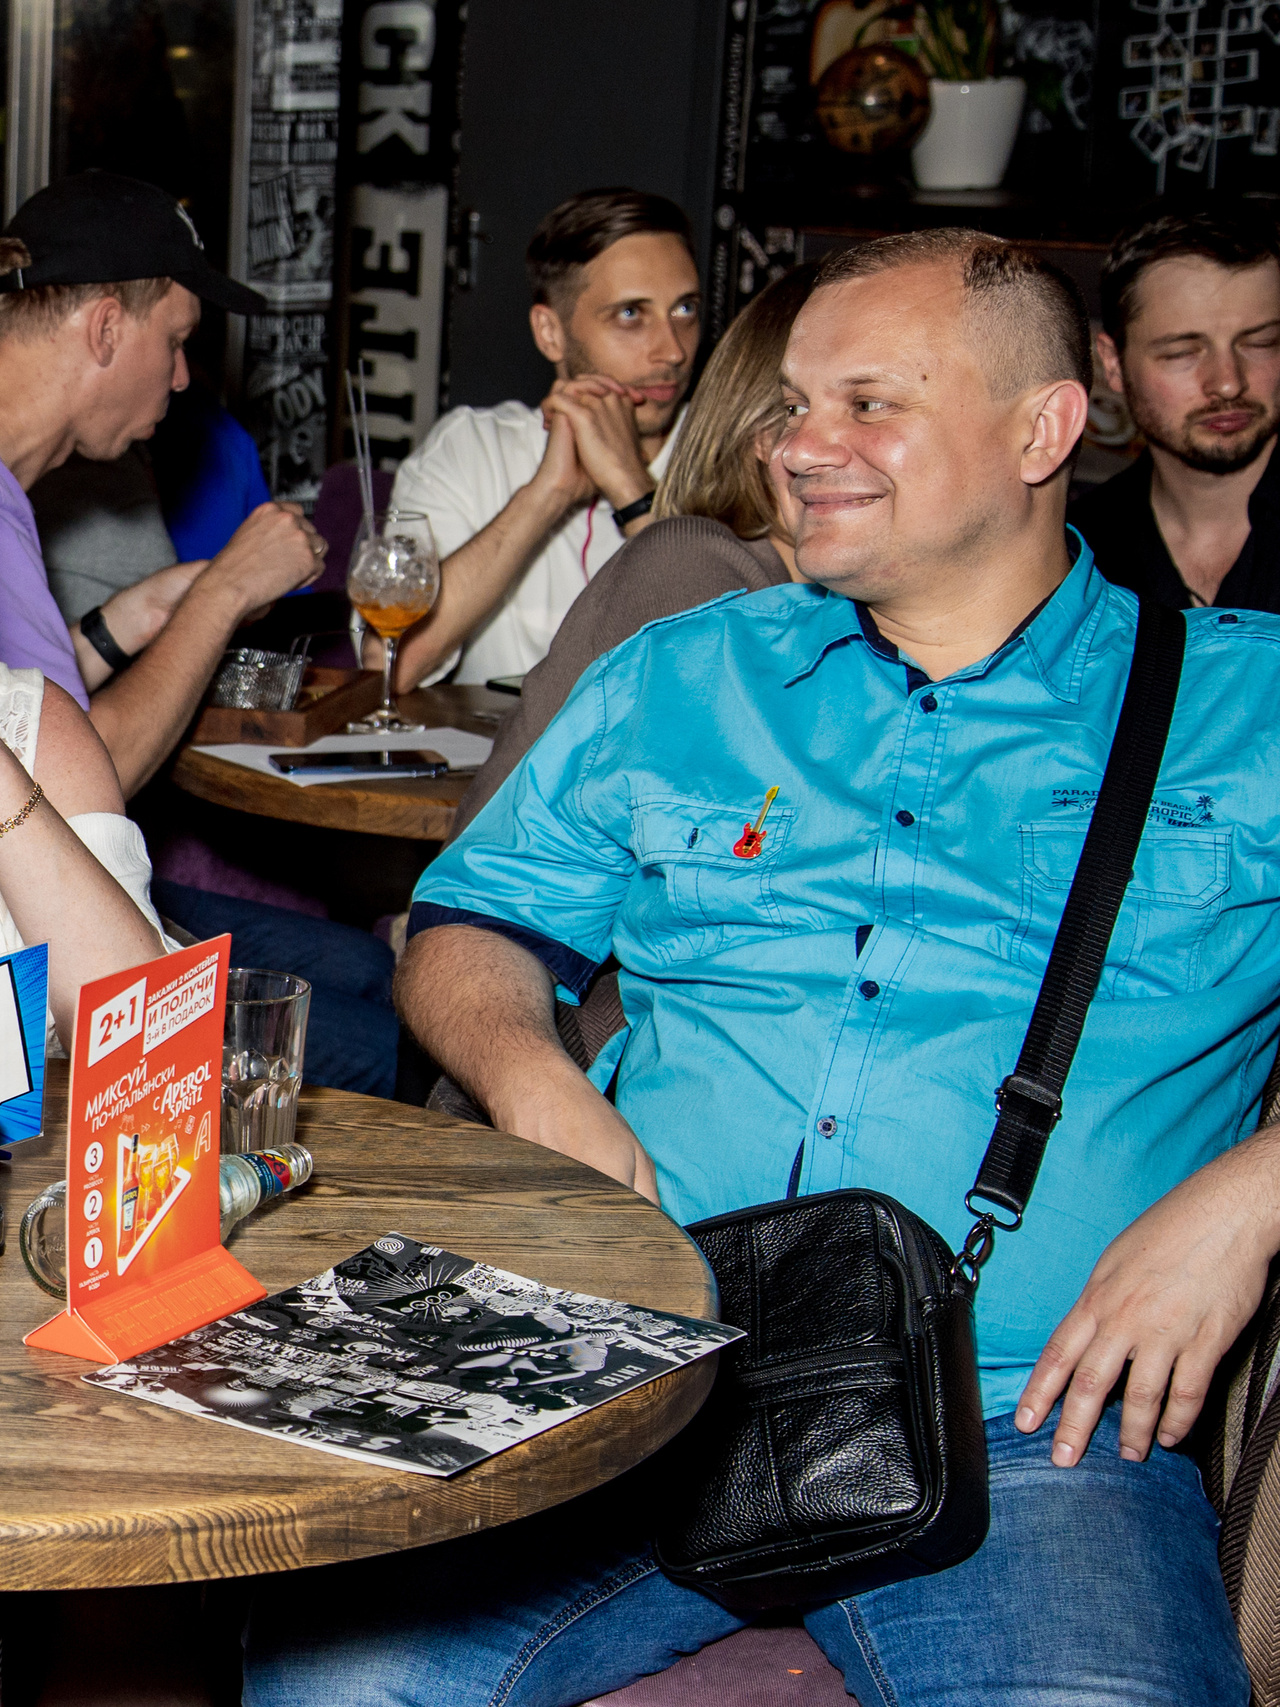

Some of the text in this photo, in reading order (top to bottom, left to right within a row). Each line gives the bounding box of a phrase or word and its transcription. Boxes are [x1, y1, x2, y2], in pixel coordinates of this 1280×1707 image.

[1150, 806, 1193, 821] ROPIC
[1161, 801, 1192, 812] BEACH
[146, 979, 179, 1006] ЗАКАЖИ
[185, 951, 220, 980] КОКТЕЙЛЯ
[148, 971, 215, 1028] И ПОЛУЧИ
[98, 994, 137, 1048] 2+1
[161, 1023, 168, 1035] В
[168, 992, 212, 1031] ПОДАРОК
[84, 1057, 148, 1122] МИКСУЙ
[91, 1064, 176, 1133] ПО-ИТАЛЬЯНСКИ
[160, 1060, 211, 1115] APEROL
[90, 1147, 98, 1167] 3
[90, 1195, 98, 1215] 2
[501, 1347, 559, 1360] SAFE
[593, 1364, 647, 1388] ENTER
[271, 1424, 332, 1442] CITY
[358, 1435, 402, 1451] 5
